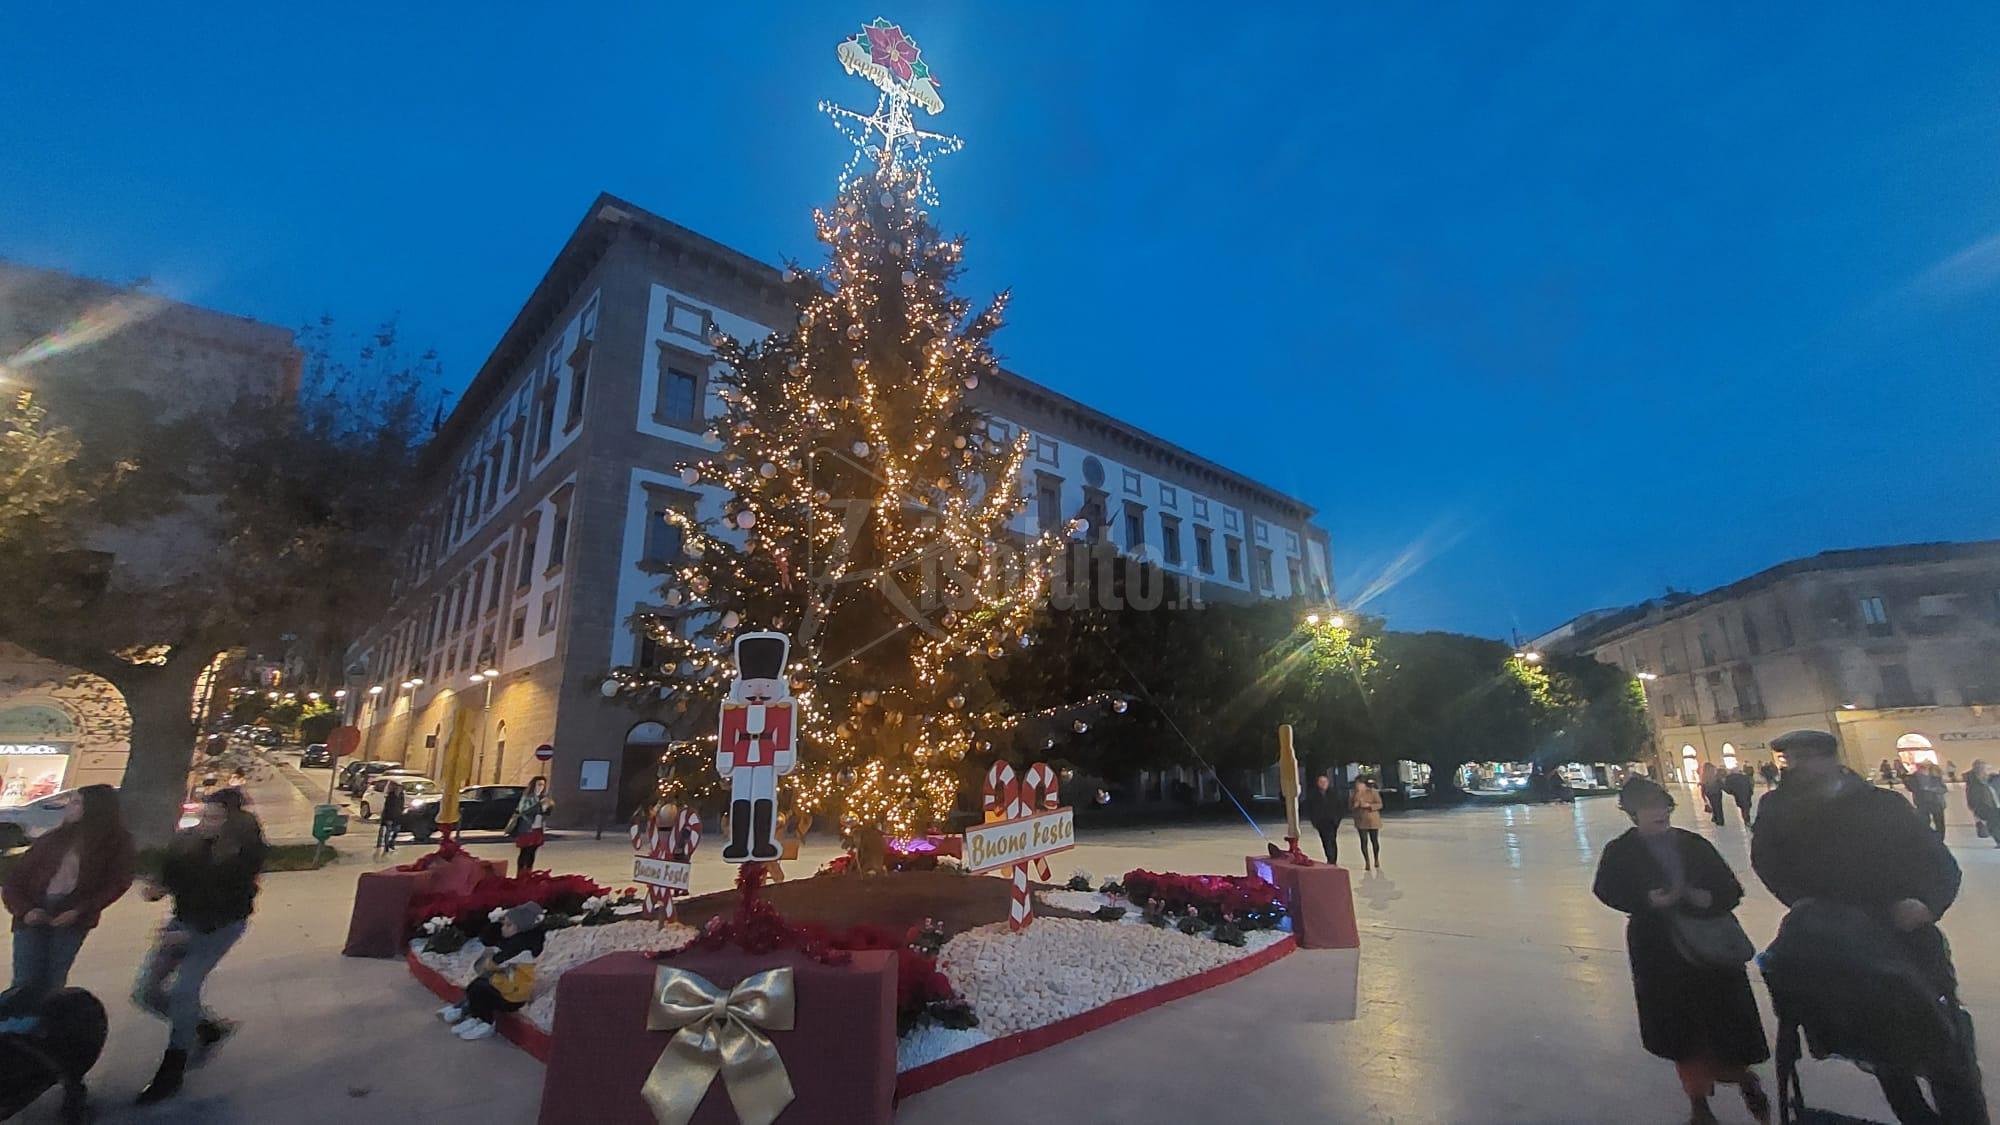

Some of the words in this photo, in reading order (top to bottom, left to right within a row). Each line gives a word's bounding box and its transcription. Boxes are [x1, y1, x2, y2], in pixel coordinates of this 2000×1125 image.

[839, 46, 887, 84] Happy
[971, 834, 1027, 866] Buone
[1032, 816, 1072, 847] Feste
